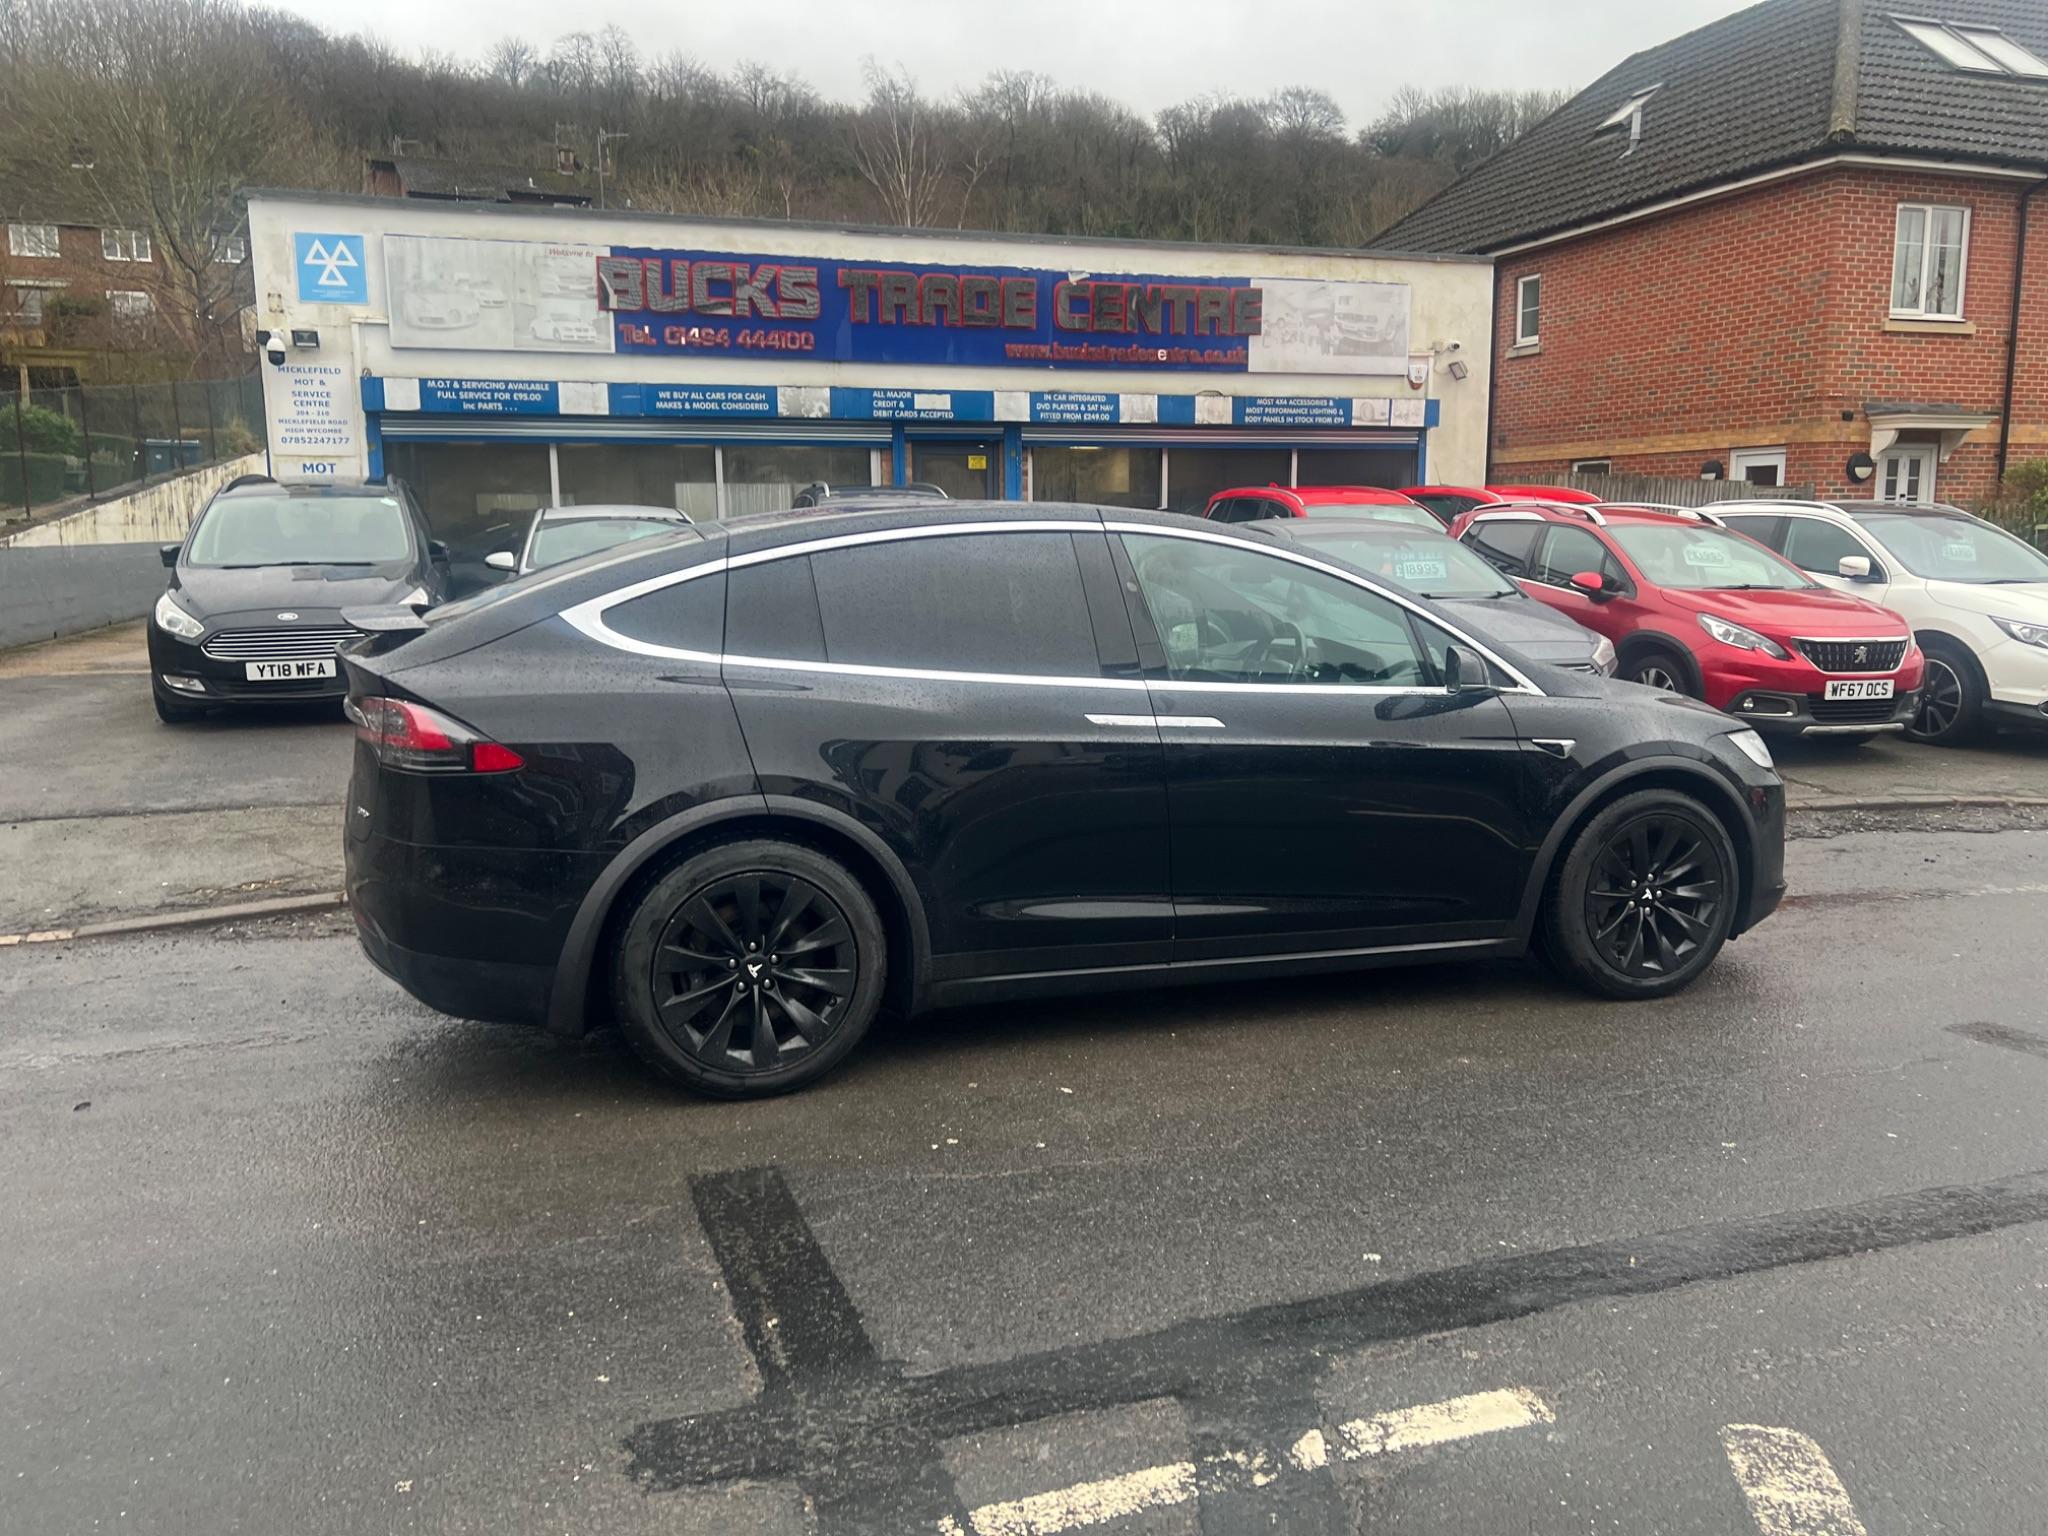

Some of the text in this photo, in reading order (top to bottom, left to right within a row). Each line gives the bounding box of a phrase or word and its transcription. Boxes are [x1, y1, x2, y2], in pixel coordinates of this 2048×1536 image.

[596, 256, 1263, 336] BUCKS TRADE CENTRE
[735, 328, 815, 351] 444100
[278, 366, 341, 375] MICKLEFIELD
[294, 378, 314, 386] MOT
[462, 382, 506, 390] SERVICING
[508, 382, 550, 392] AVAILABLE
[437, 391, 457, 400] FULL
[460, 392, 492, 400] SERVICE
[494, 392, 510, 400] FOR
[658, 391, 766, 401] WE BUY ALL CARS FOR CASH
[873, 390, 912, 399] ALL MAJOR
[1053, 394, 1067, 402] CAR
[1068, 394, 1106, 402] INTEGRATED
[294, 400, 330, 408] CENTRE
[478, 402, 503, 411] PARTS
[656, 401, 770, 411] MAKES & MODEL CONSIDERED
[873, 400, 905, 408] CREDIT &
[1256, 398, 1274, 406] MOST
[1288, 398, 1327, 406] ACCESSORIES
[1052, 404, 1079, 412] PLAYERS
[1080, 404, 1086, 412] &
[1087, 404, 1098, 412] SAT
[1100, 404, 1114, 412] NAV
[1264, 407, 1308, 416] PERFORMANCE
[1309, 408, 1338, 416] LIGHTING
[873, 410, 954, 420] DEBIT CARDS ACCEPTED
[1040, 412, 1061, 420] FITTED
[1062, 412, 1082, 420] FROM
[1245, 416, 1262, 424] BODY
[1264, 416, 1284, 424] PANELS
[1315, 417, 1332, 425] FROM
[302, 463, 336, 474] MOT
[257, 662, 326, 678] YT18 WFA
[1831, 682, 1888, 697] WF67 OCS
